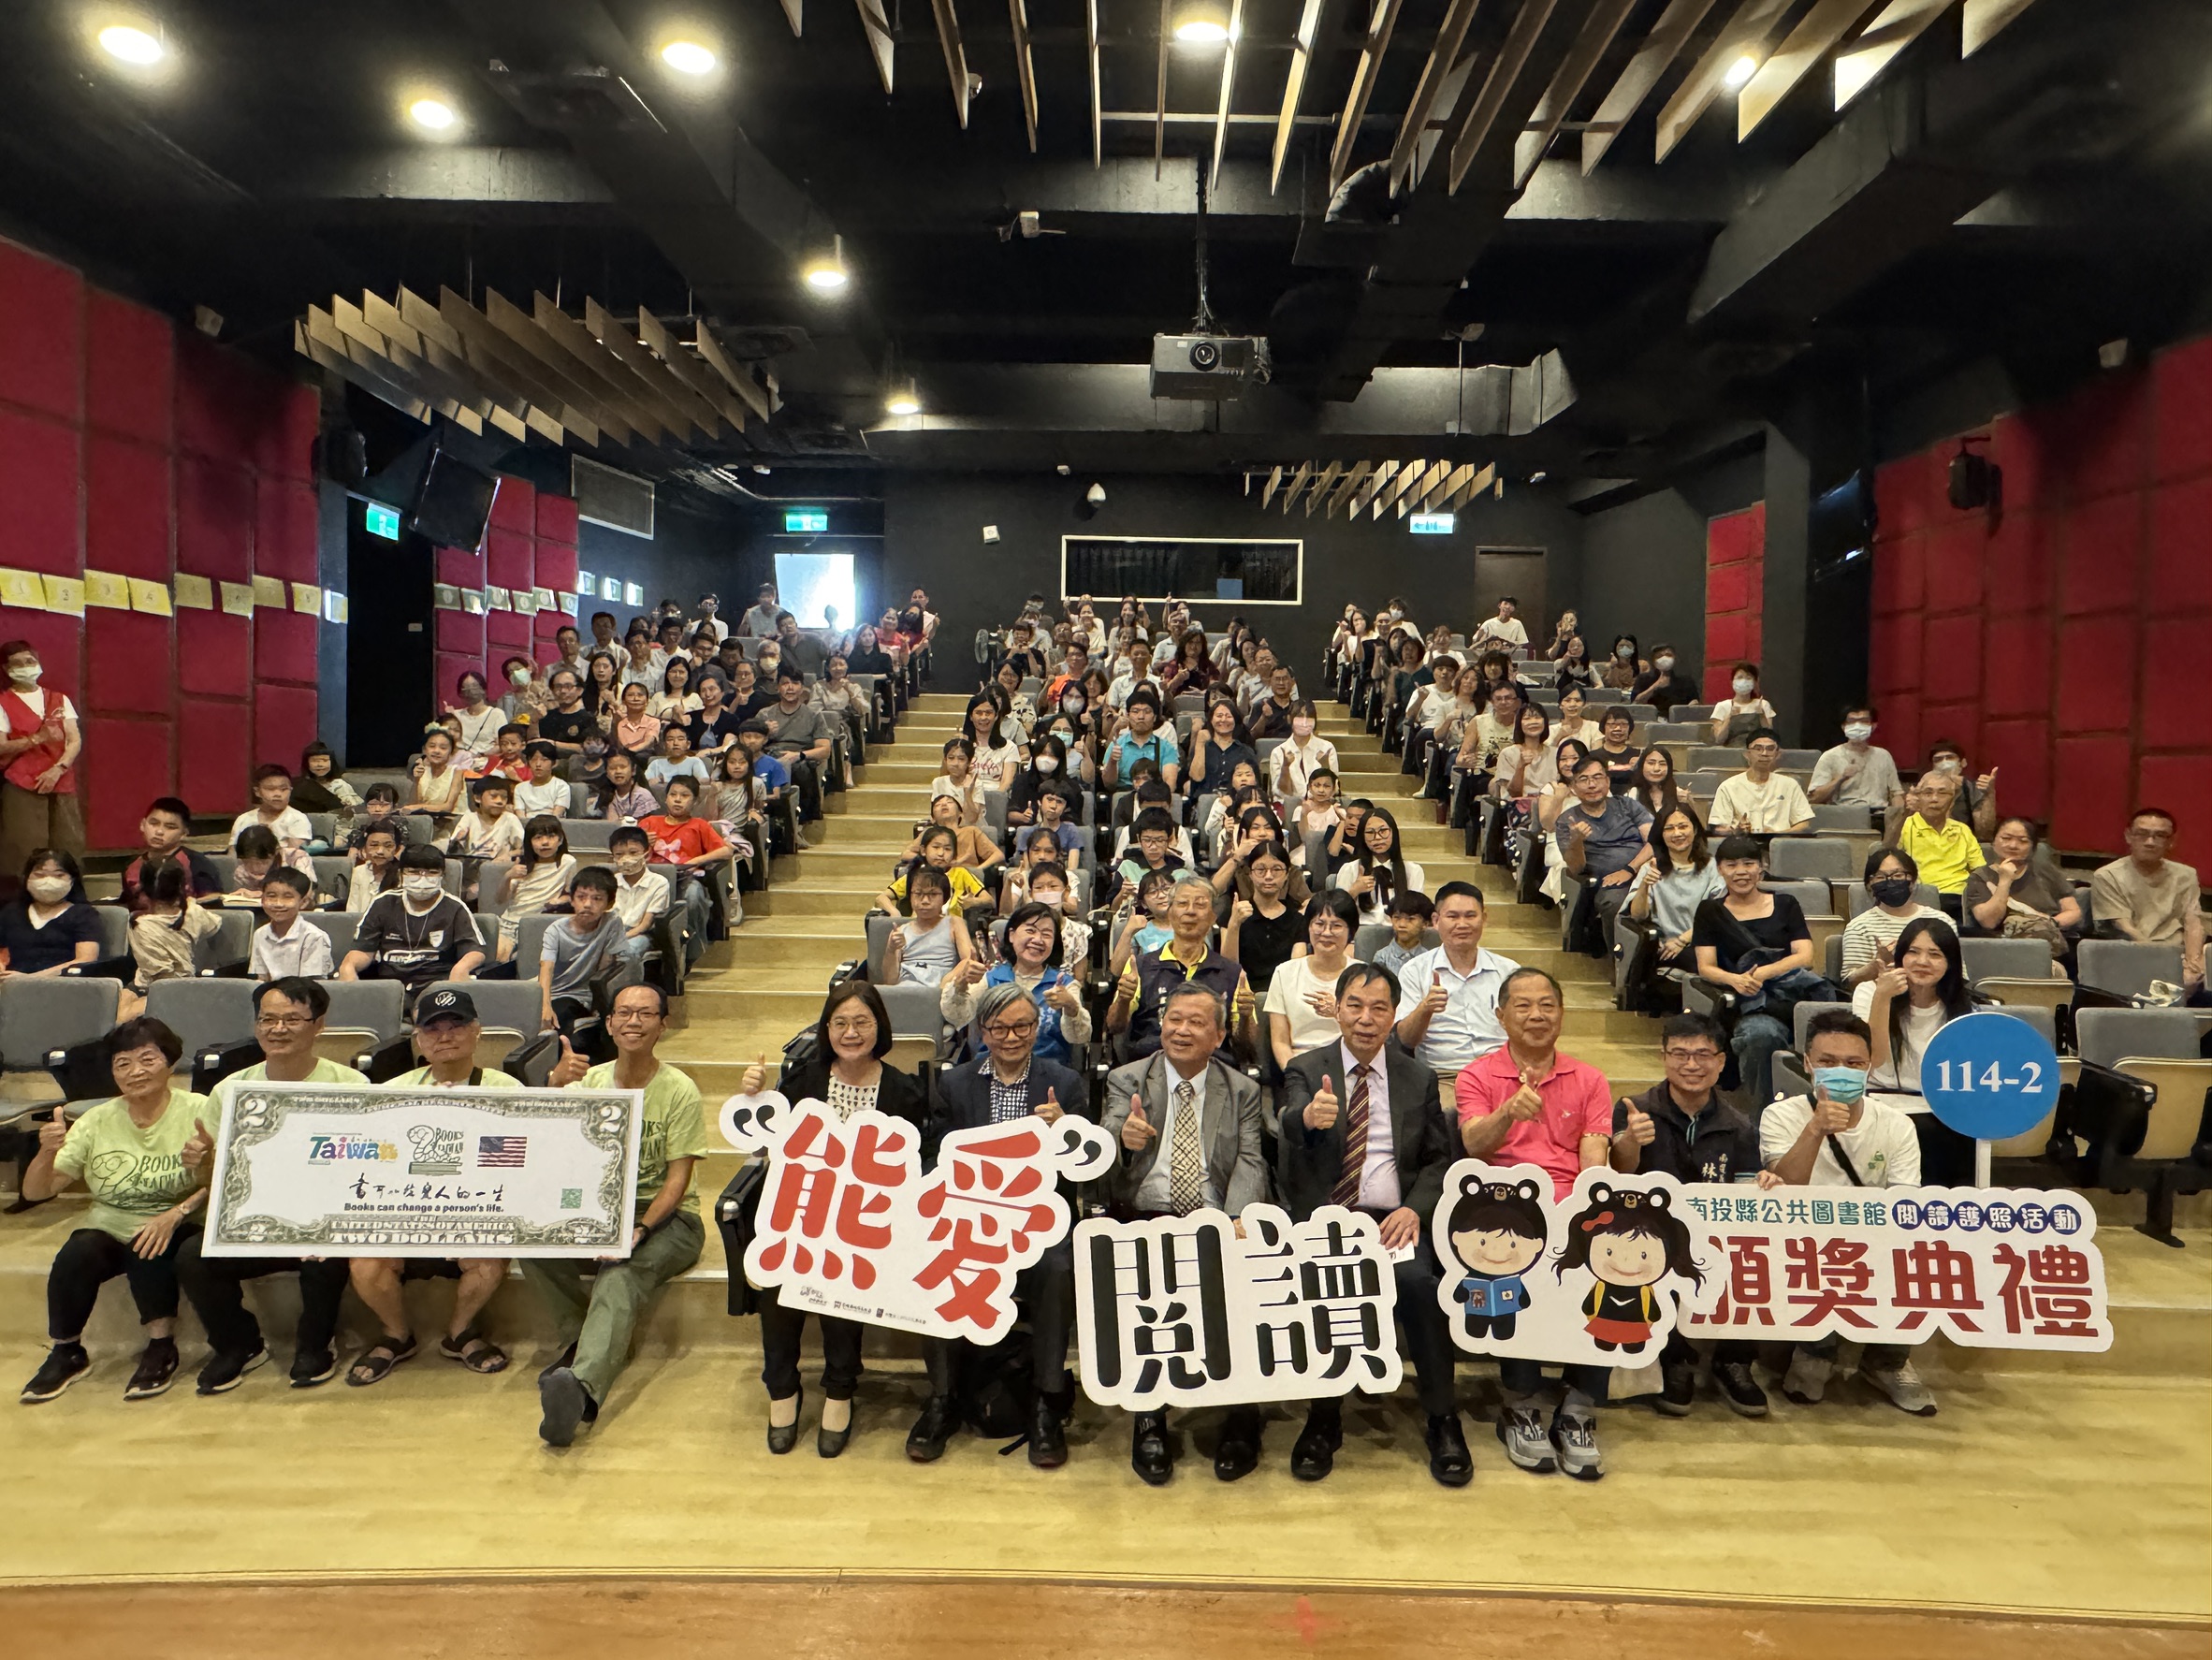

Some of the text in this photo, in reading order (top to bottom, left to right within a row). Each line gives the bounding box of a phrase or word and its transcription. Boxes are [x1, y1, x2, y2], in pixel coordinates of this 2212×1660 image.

[1936, 1059, 2044, 1094] 114-2
[242, 1098, 267, 1128] 2
[599, 1105, 622, 1133] 2
[310, 1136, 399, 1160] Taiwan
[139, 1154, 183, 1172] BOOK
[344, 1202, 374, 1211] Books
[397, 1203, 432, 1213] change
[443, 1203, 484, 1214] person's
[486, 1203, 504, 1212] life.
[1685, 1197, 2078, 1232] 南投縣公共圖書館 閱讀護照活動
[330, 1232, 514, 1245] TWO DOLLARS
[1089, 1219, 1388, 1394] 閱讀
